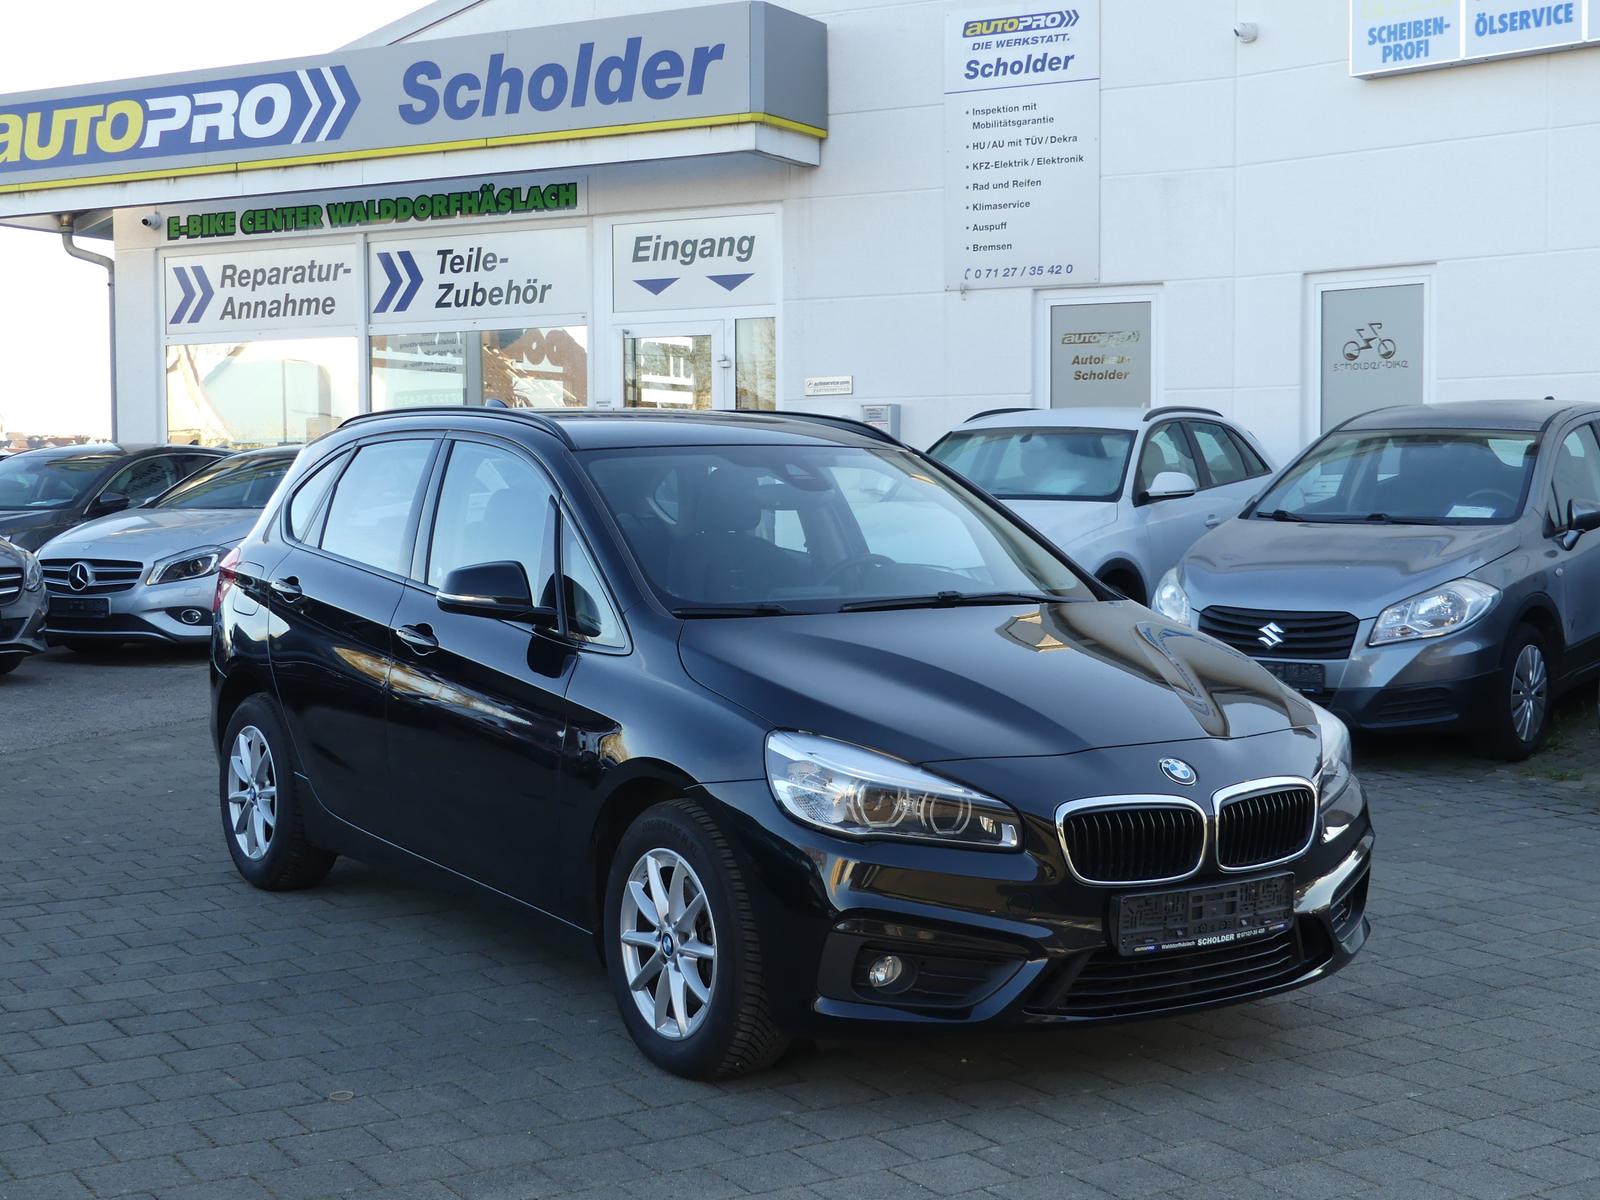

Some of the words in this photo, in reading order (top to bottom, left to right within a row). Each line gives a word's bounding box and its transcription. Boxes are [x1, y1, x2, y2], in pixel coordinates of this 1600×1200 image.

[1367, 16, 1451, 46] SCHEIBEN-
[1475, 2, 1574, 37] ÖLSERVICE
[972, 41, 992, 51] DIE
[996, 33, 1071, 49] WERKSTATT.
[1381, 39, 1430, 63] PROFI
[964, 53, 1075, 80] Scholder
[399, 36, 726, 126] Scholder
[972, 104, 1020, 116] Inspektion
[1022, 102, 1037, 112] mit
[972, 115, 1055, 130] Mobilitätsgarantie
[1008, 136, 1022, 147] mit
[972, 182, 990, 191] Rad
[992, 181, 1010, 190] und
[1012, 178, 1042, 189] Reifen
[167, 211, 237, 241] E-BIKE
[240, 205, 324, 234] CENTER
[327, 183, 578, 230] WALDDORFHÄSLACH
[972, 200, 1031, 212] Klimaservice
[972, 222, 1008, 233] Auspuff
[631, 234, 756, 266] Eingang
[972, 243, 1013, 252] Bremsen
[436, 246, 509, 276] Teile-
[220, 259, 352, 293] Reparatur-
[435, 280, 553, 310] Zubehör
[219, 295, 336, 322] Annahme
[1073, 369, 1130, 381] Scholder
[1197, 933, 1236, 946] SCHOLDER
